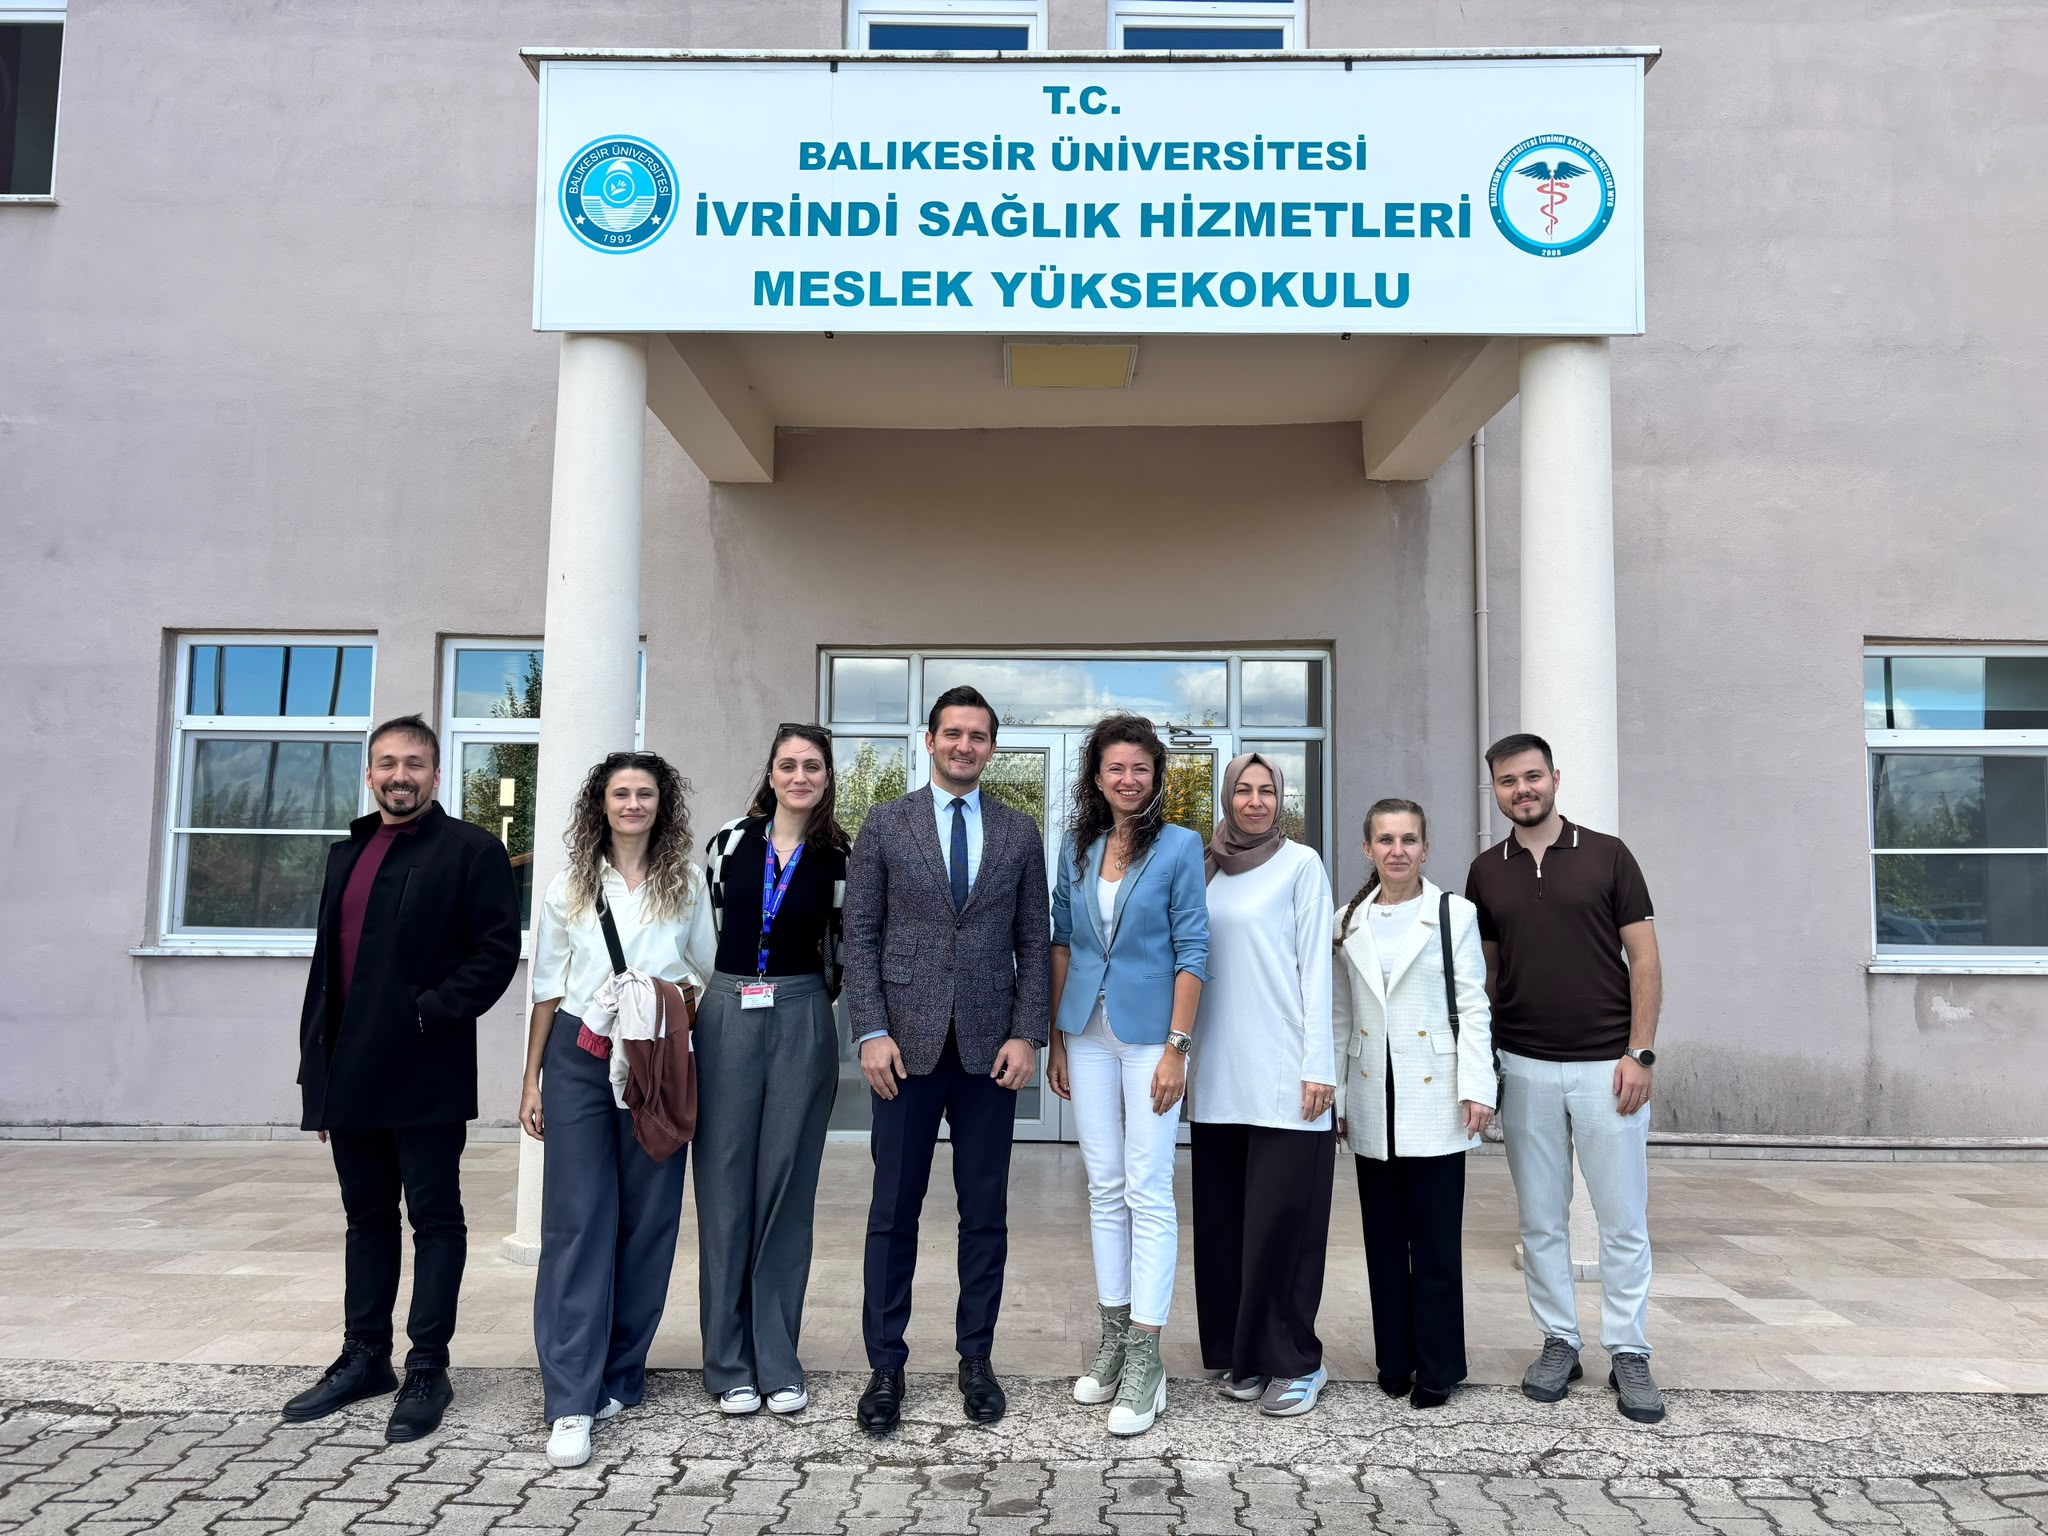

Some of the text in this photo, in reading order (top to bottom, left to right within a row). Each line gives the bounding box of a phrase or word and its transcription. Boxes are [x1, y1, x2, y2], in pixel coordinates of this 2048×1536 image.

[1043, 86, 1121, 115] T.C.
[569, 145, 671, 196] BALIKESİR ÜNİVERSİTESİ
[800, 134, 1367, 171] BALIKESİR ÜNİVERSİTESİ
[696, 193, 1471, 239] İVRİNDİ SAĞLIK HİZMETLERİ
[603, 234, 632, 244] 1992
[754, 265, 1410, 309] MESLEK YÜKSEKOKULU
